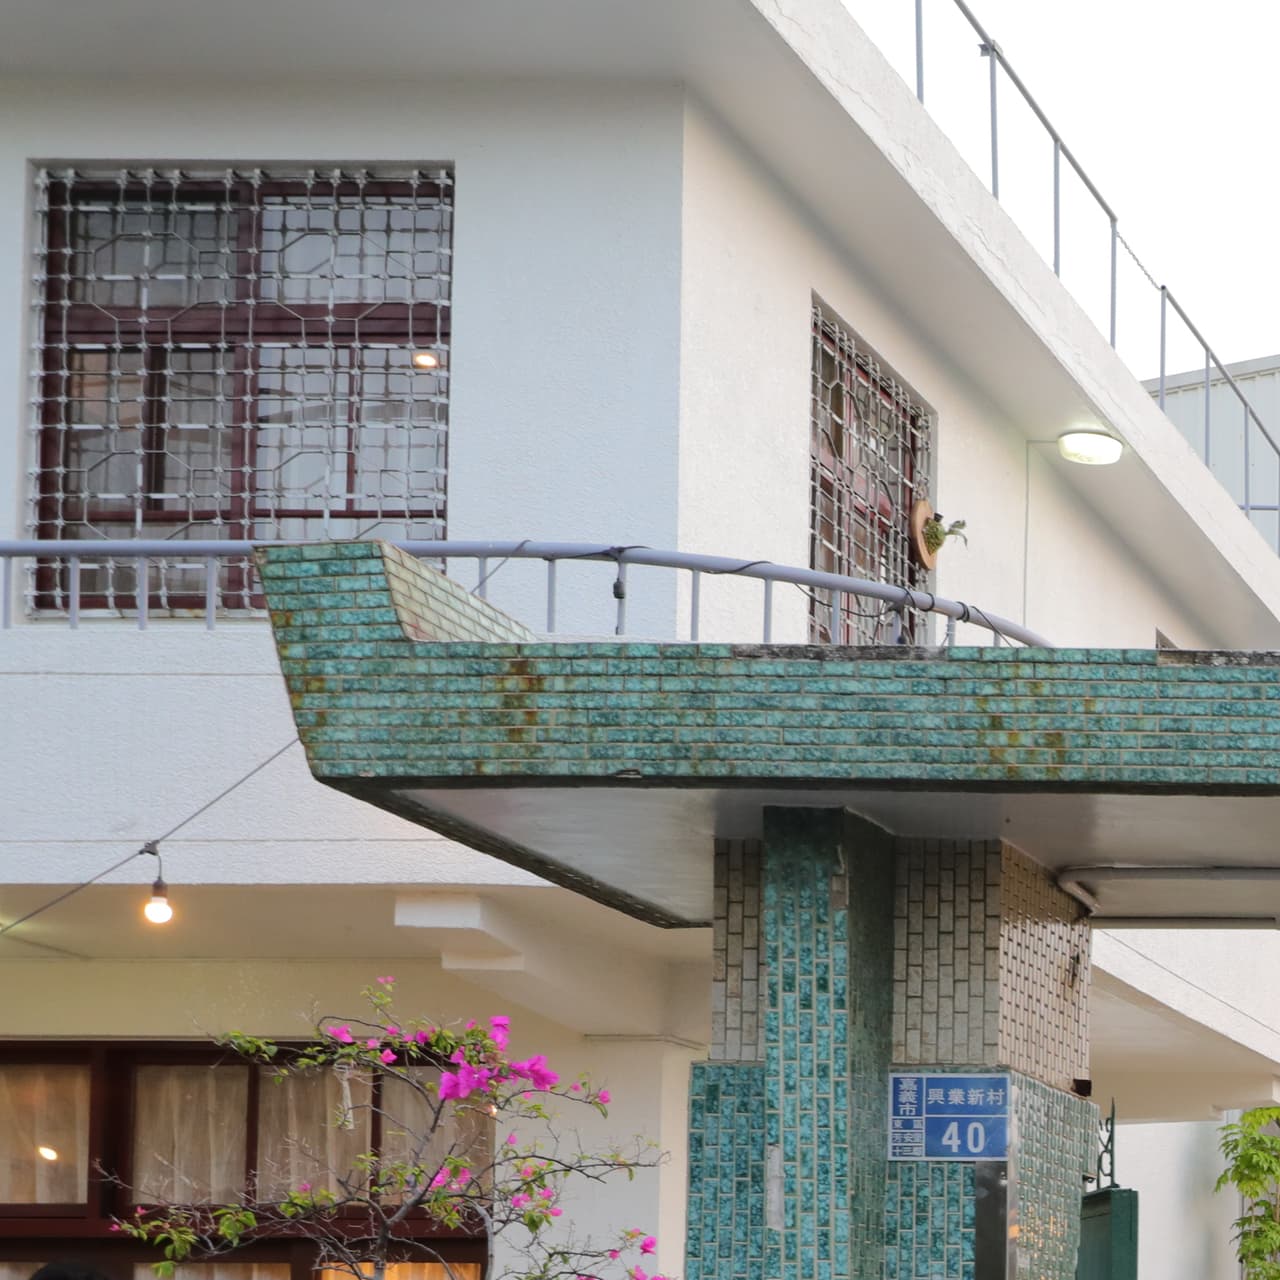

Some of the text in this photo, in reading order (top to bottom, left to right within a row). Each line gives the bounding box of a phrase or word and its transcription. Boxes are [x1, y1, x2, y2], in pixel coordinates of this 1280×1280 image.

[898, 1078, 918, 1116] 嘉義市
[927, 1088, 1005, 1106] 興業新村
[941, 1121, 985, 1153] 40
